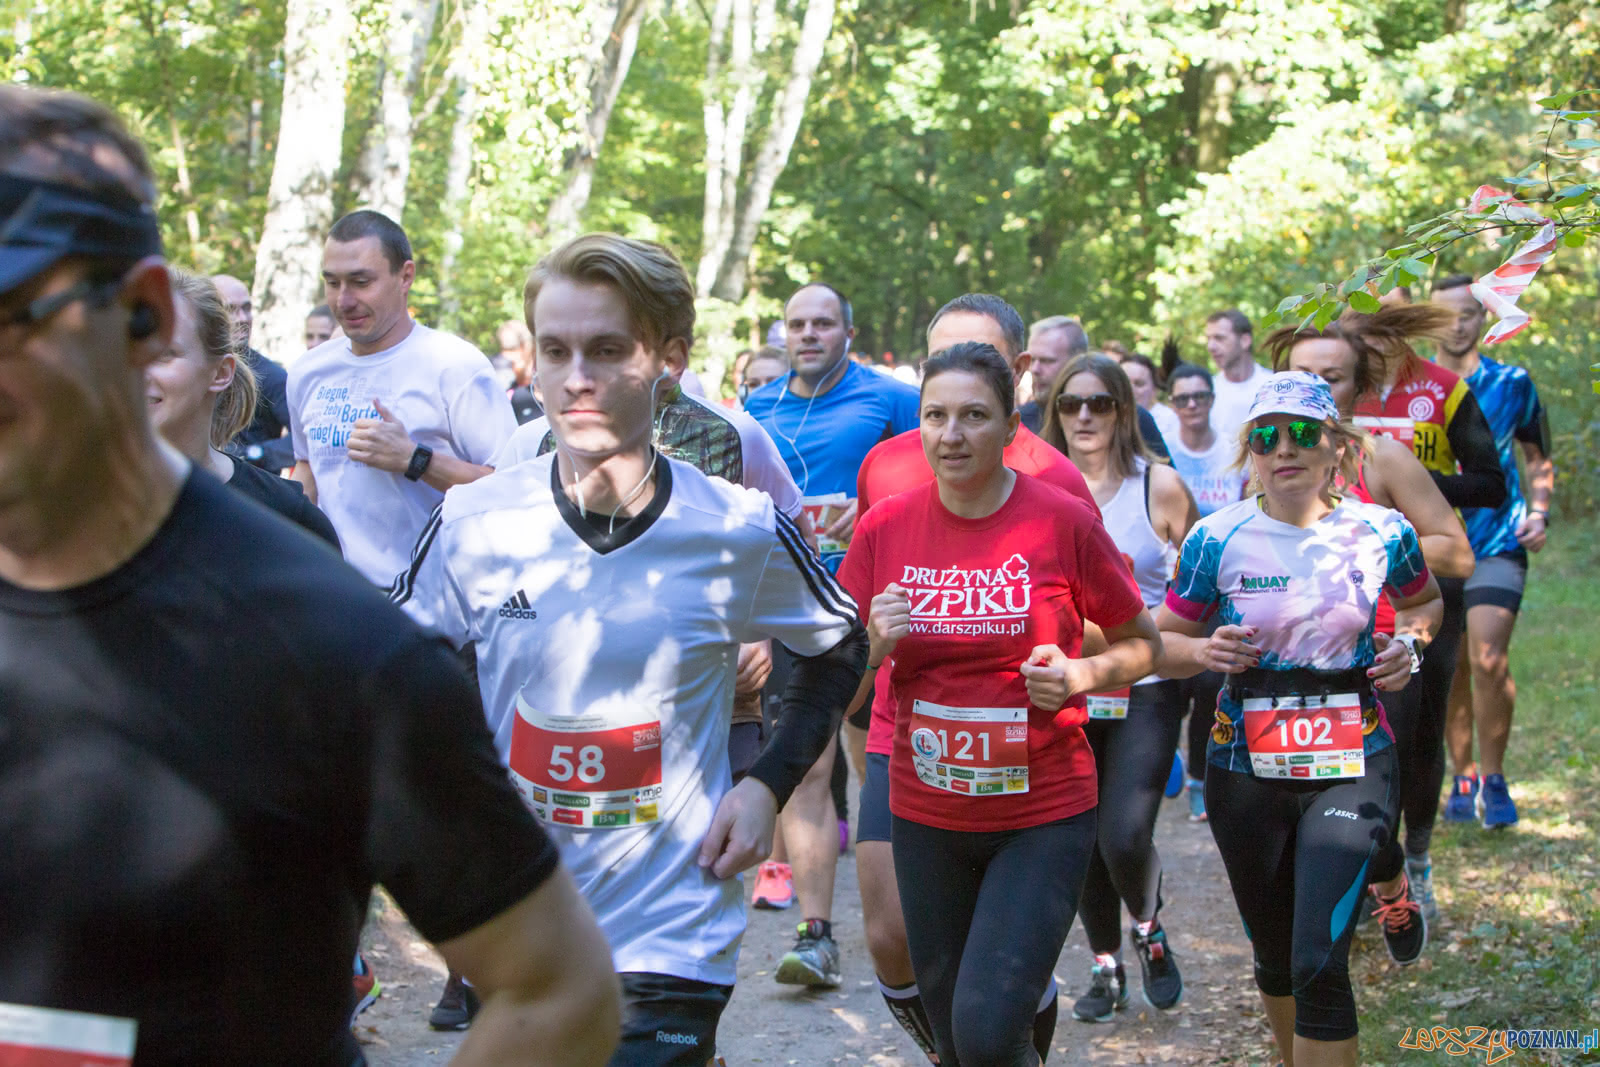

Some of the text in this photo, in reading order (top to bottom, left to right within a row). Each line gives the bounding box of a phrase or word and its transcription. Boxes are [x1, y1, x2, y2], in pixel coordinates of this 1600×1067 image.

[901, 565, 1008, 588] DRUŻYNA
[1245, 576, 1291, 589] MUAY
[499, 607, 537, 620] adidas
[1276, 717, 1333, 747] 102
[937, 729, 991, 761] 121
[547, 745, 606, 783] 58
[1335, 809, 1359, 820] asics
[656, 1030, 698, 1046] Reebok
